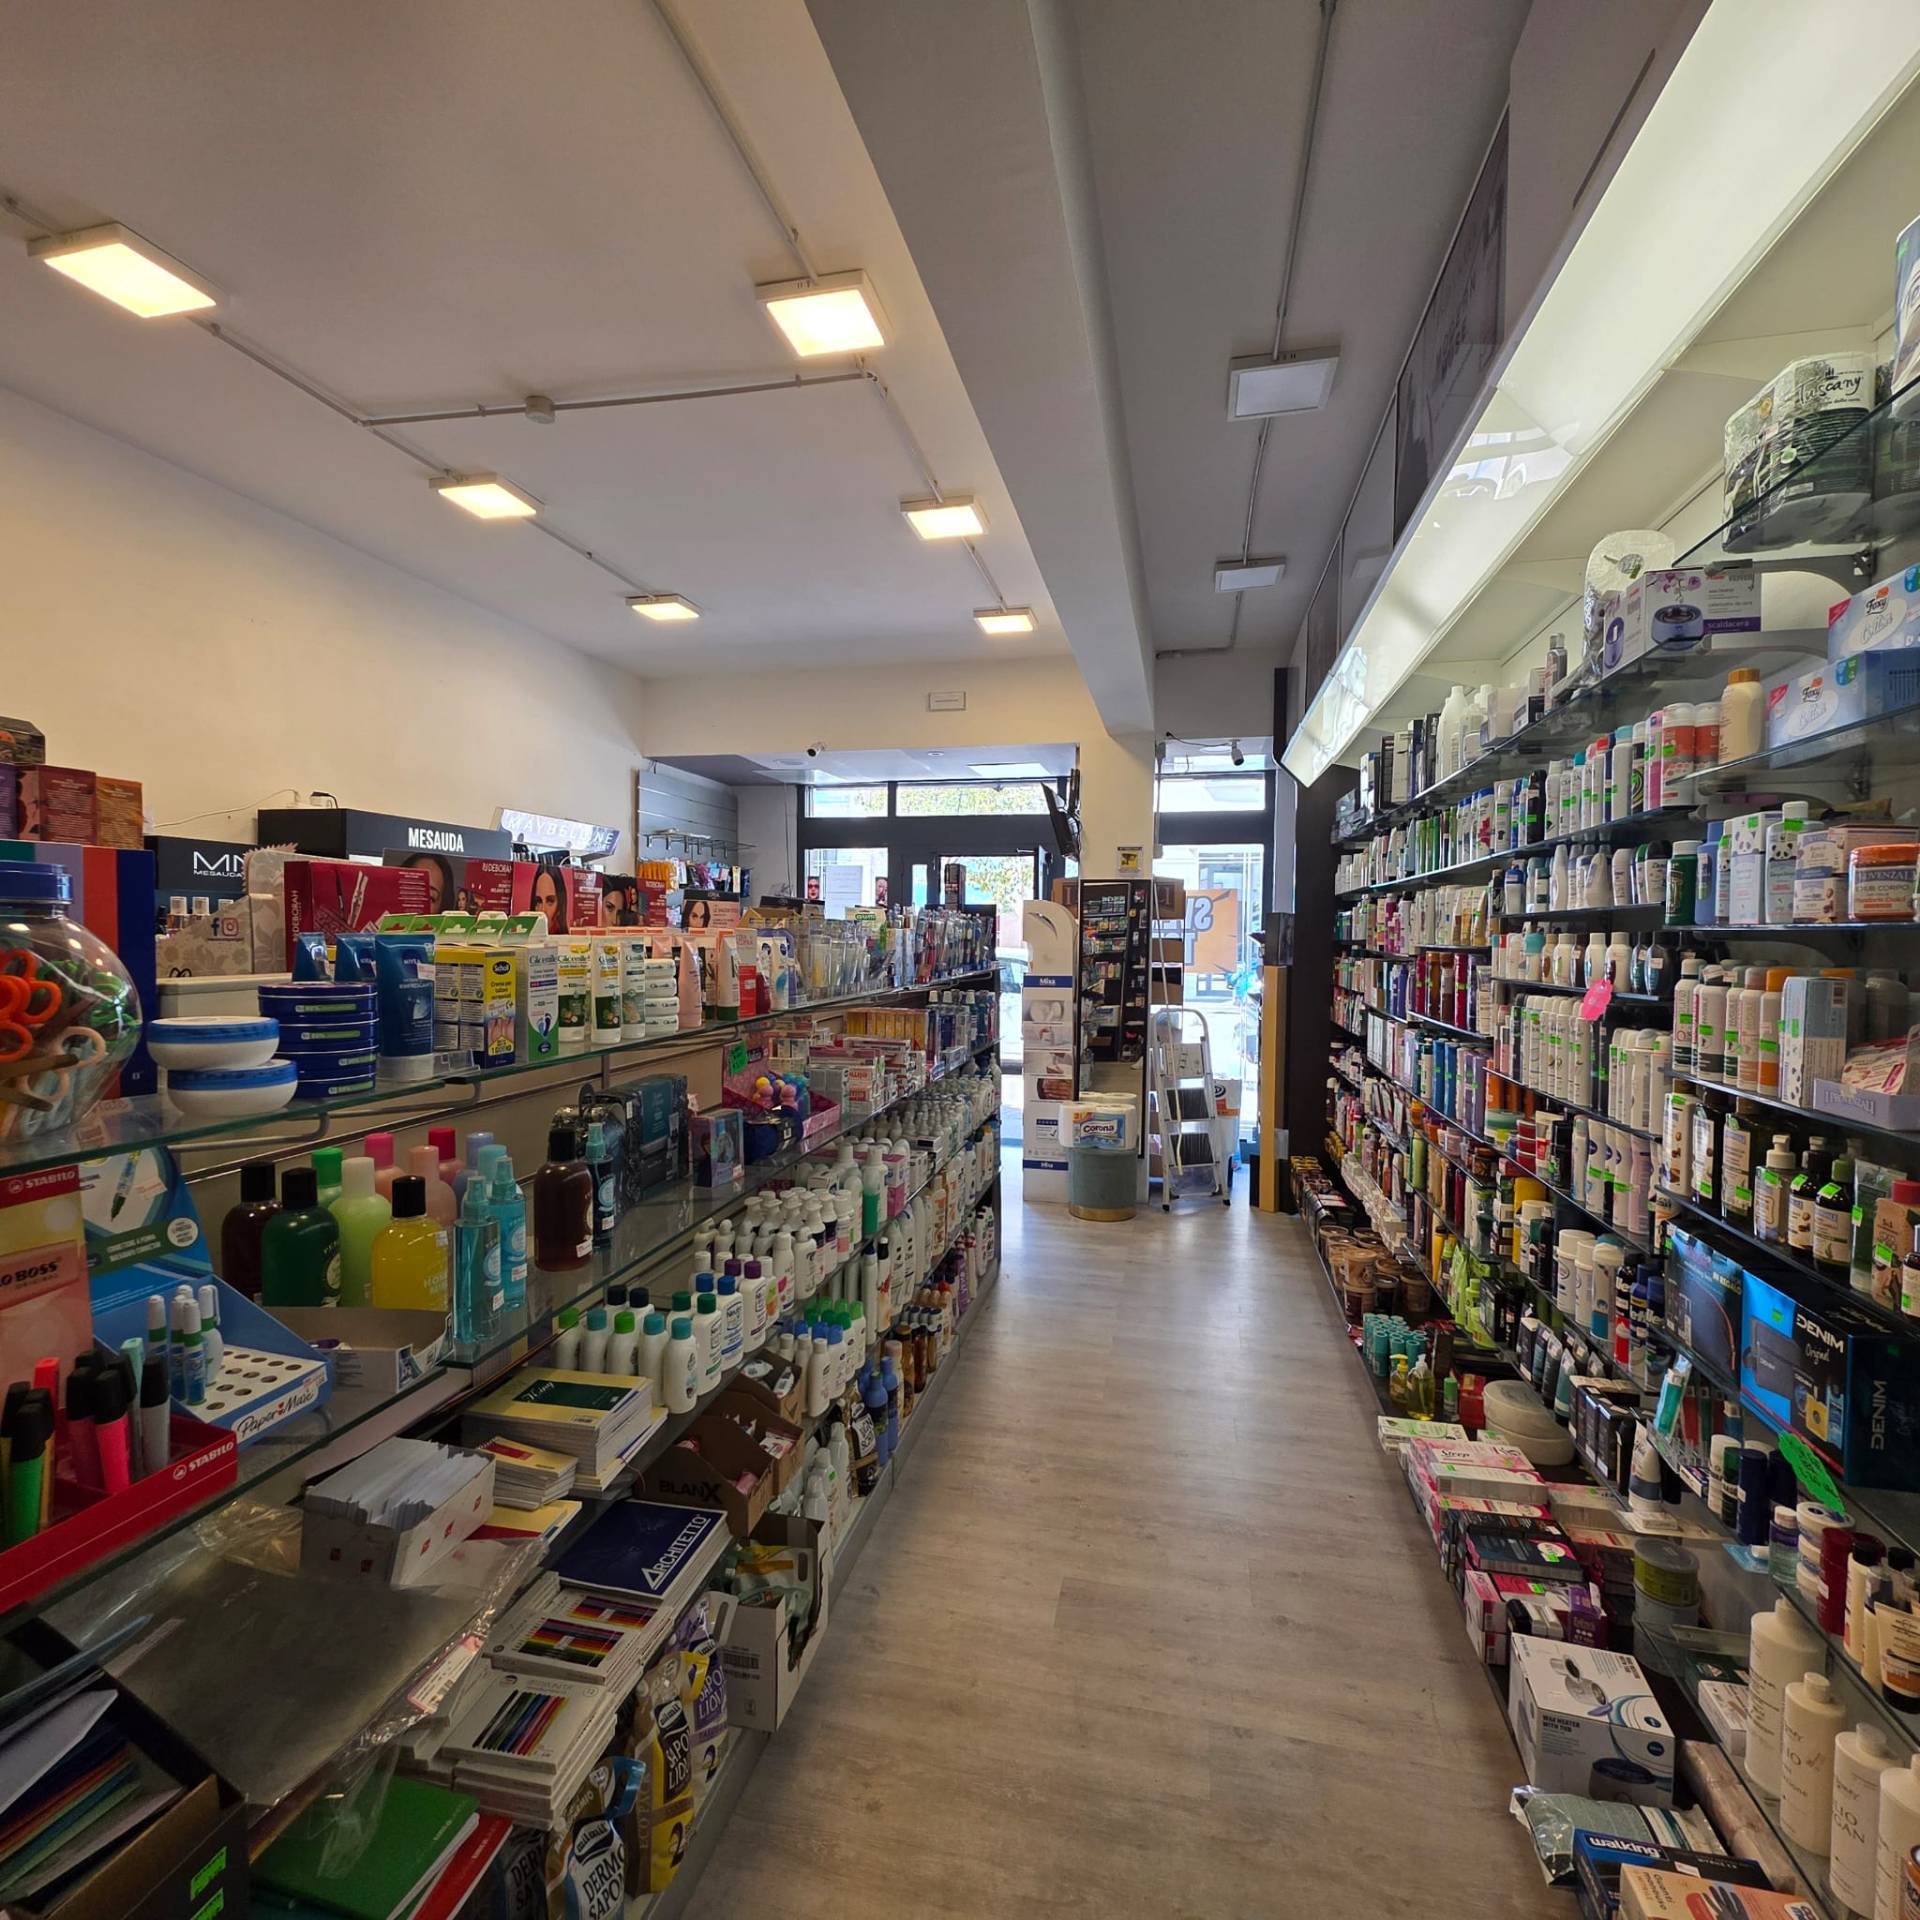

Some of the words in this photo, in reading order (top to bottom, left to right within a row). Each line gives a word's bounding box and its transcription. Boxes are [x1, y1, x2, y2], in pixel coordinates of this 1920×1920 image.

[1800, 375, 1862, 407] Tuscany
[1866, 599, 1888, 613] Foxy
[1802, 687, 1822, 701] Foxy
[408, 827, 464, 853] MESAUDA
[506, 816, 614, 844] MAYBELLINE
[193, 870, 243, 878] MESAUDA
[290, 889, 300, 934] DEBORAH
[1083, 1124, 1114, 1133] Corona
[25, 1170, 77, 1189] STABILO
[14, 1261, 58, 1281] BOSS
[1796, 1313, 1844, 1353] DENIM
[237, 1410, 277, 1438] Paper
[285, 1389, 315, 1412] Mate
[1870, 1380, 1888, 1450] DENIM
[187, 1441, 235, 1472] STABILO
[641, 1515, 708, 1590] ARCHITETTO
[1589, 1837, 1661, 1859] walking
